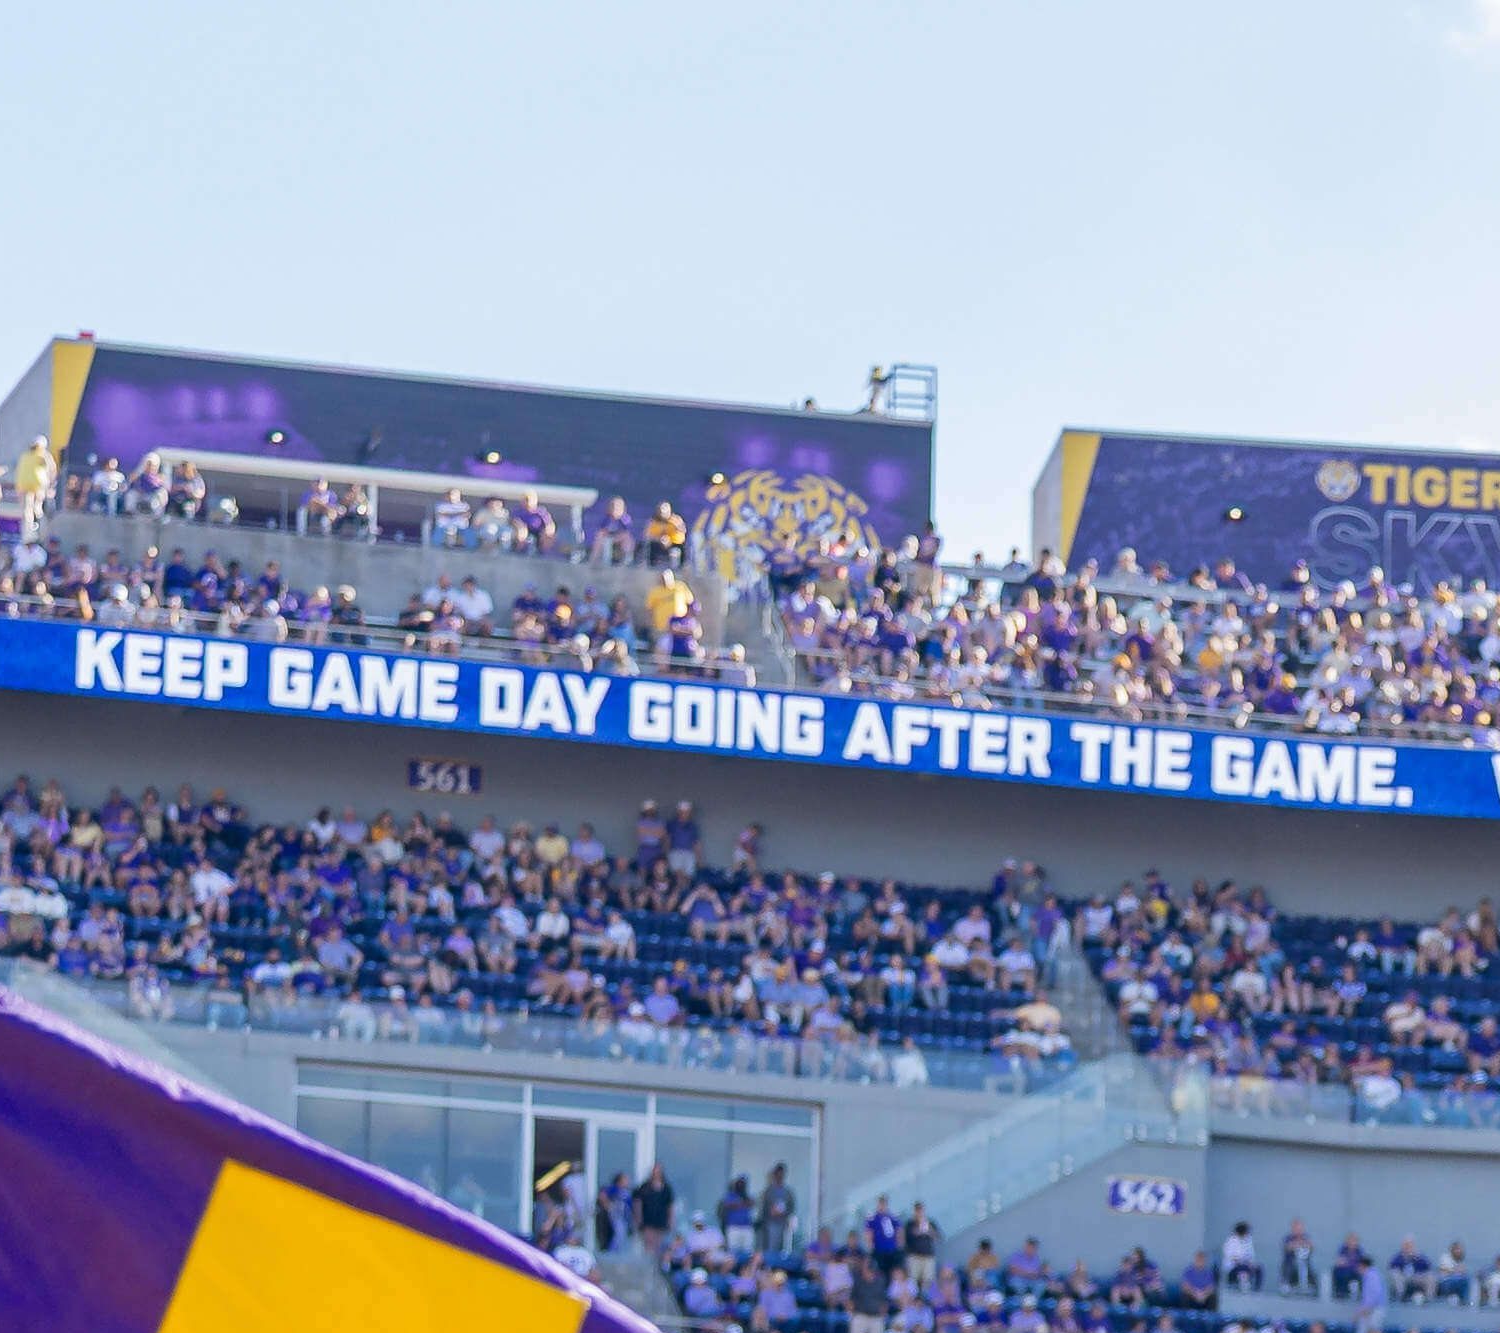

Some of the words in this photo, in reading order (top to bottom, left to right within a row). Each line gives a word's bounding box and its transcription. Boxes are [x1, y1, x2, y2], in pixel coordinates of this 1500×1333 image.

[75, 629, 249, 701] KEEP
[268, 647, 460, 723] GAME
[479, 666, 611, 736] DAY
[628, 680, 825, 758] GOING
[842, 701, 1052, 779] AFTER
[1071, 724, 1193, 790] THE
[1210, 734, 1414, 808] GAME.
[418, 763, 474, 794] 561
[1118, 1180, 1177, 1215] 562
